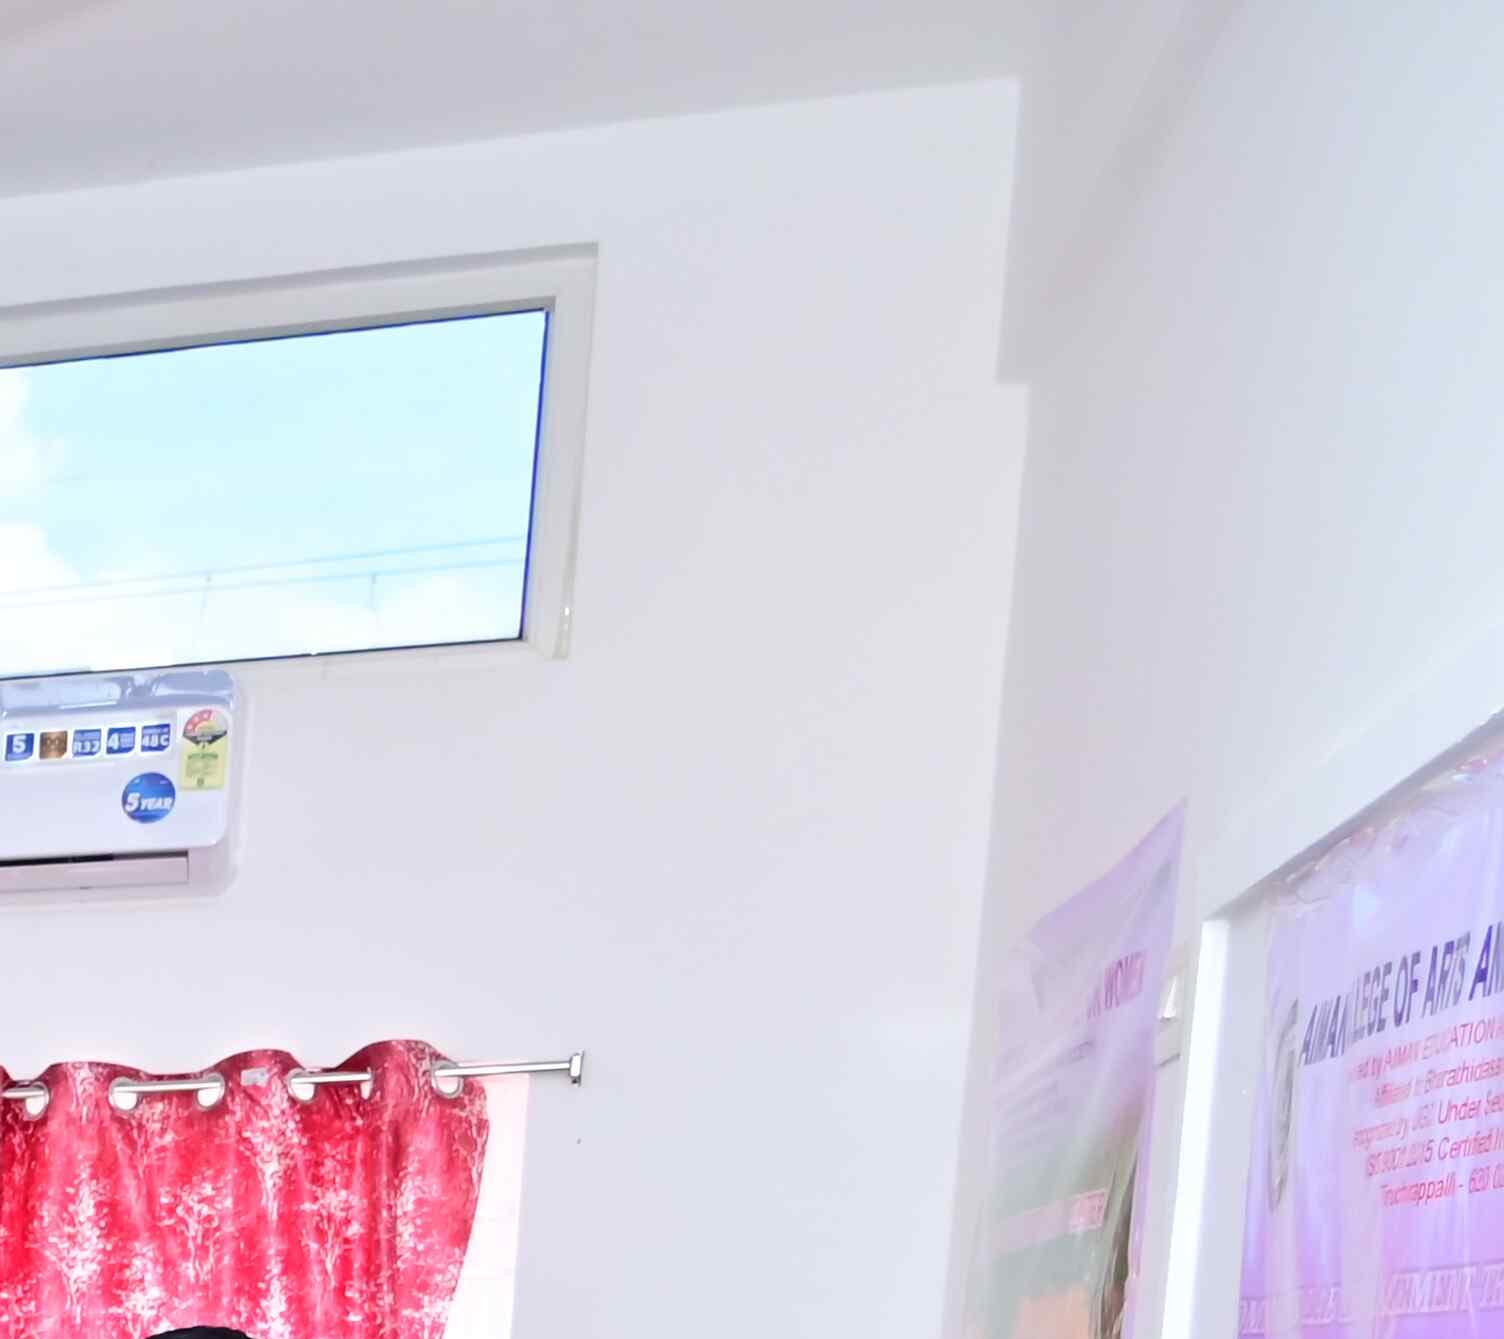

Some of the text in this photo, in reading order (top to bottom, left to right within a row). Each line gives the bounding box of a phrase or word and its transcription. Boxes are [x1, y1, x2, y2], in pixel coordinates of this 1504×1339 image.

[125, 792, 172, 812] 5 YEAR
[1394, 951, 1421, 1027] OF
[1421, 931, 1471, 1018] ARTS
